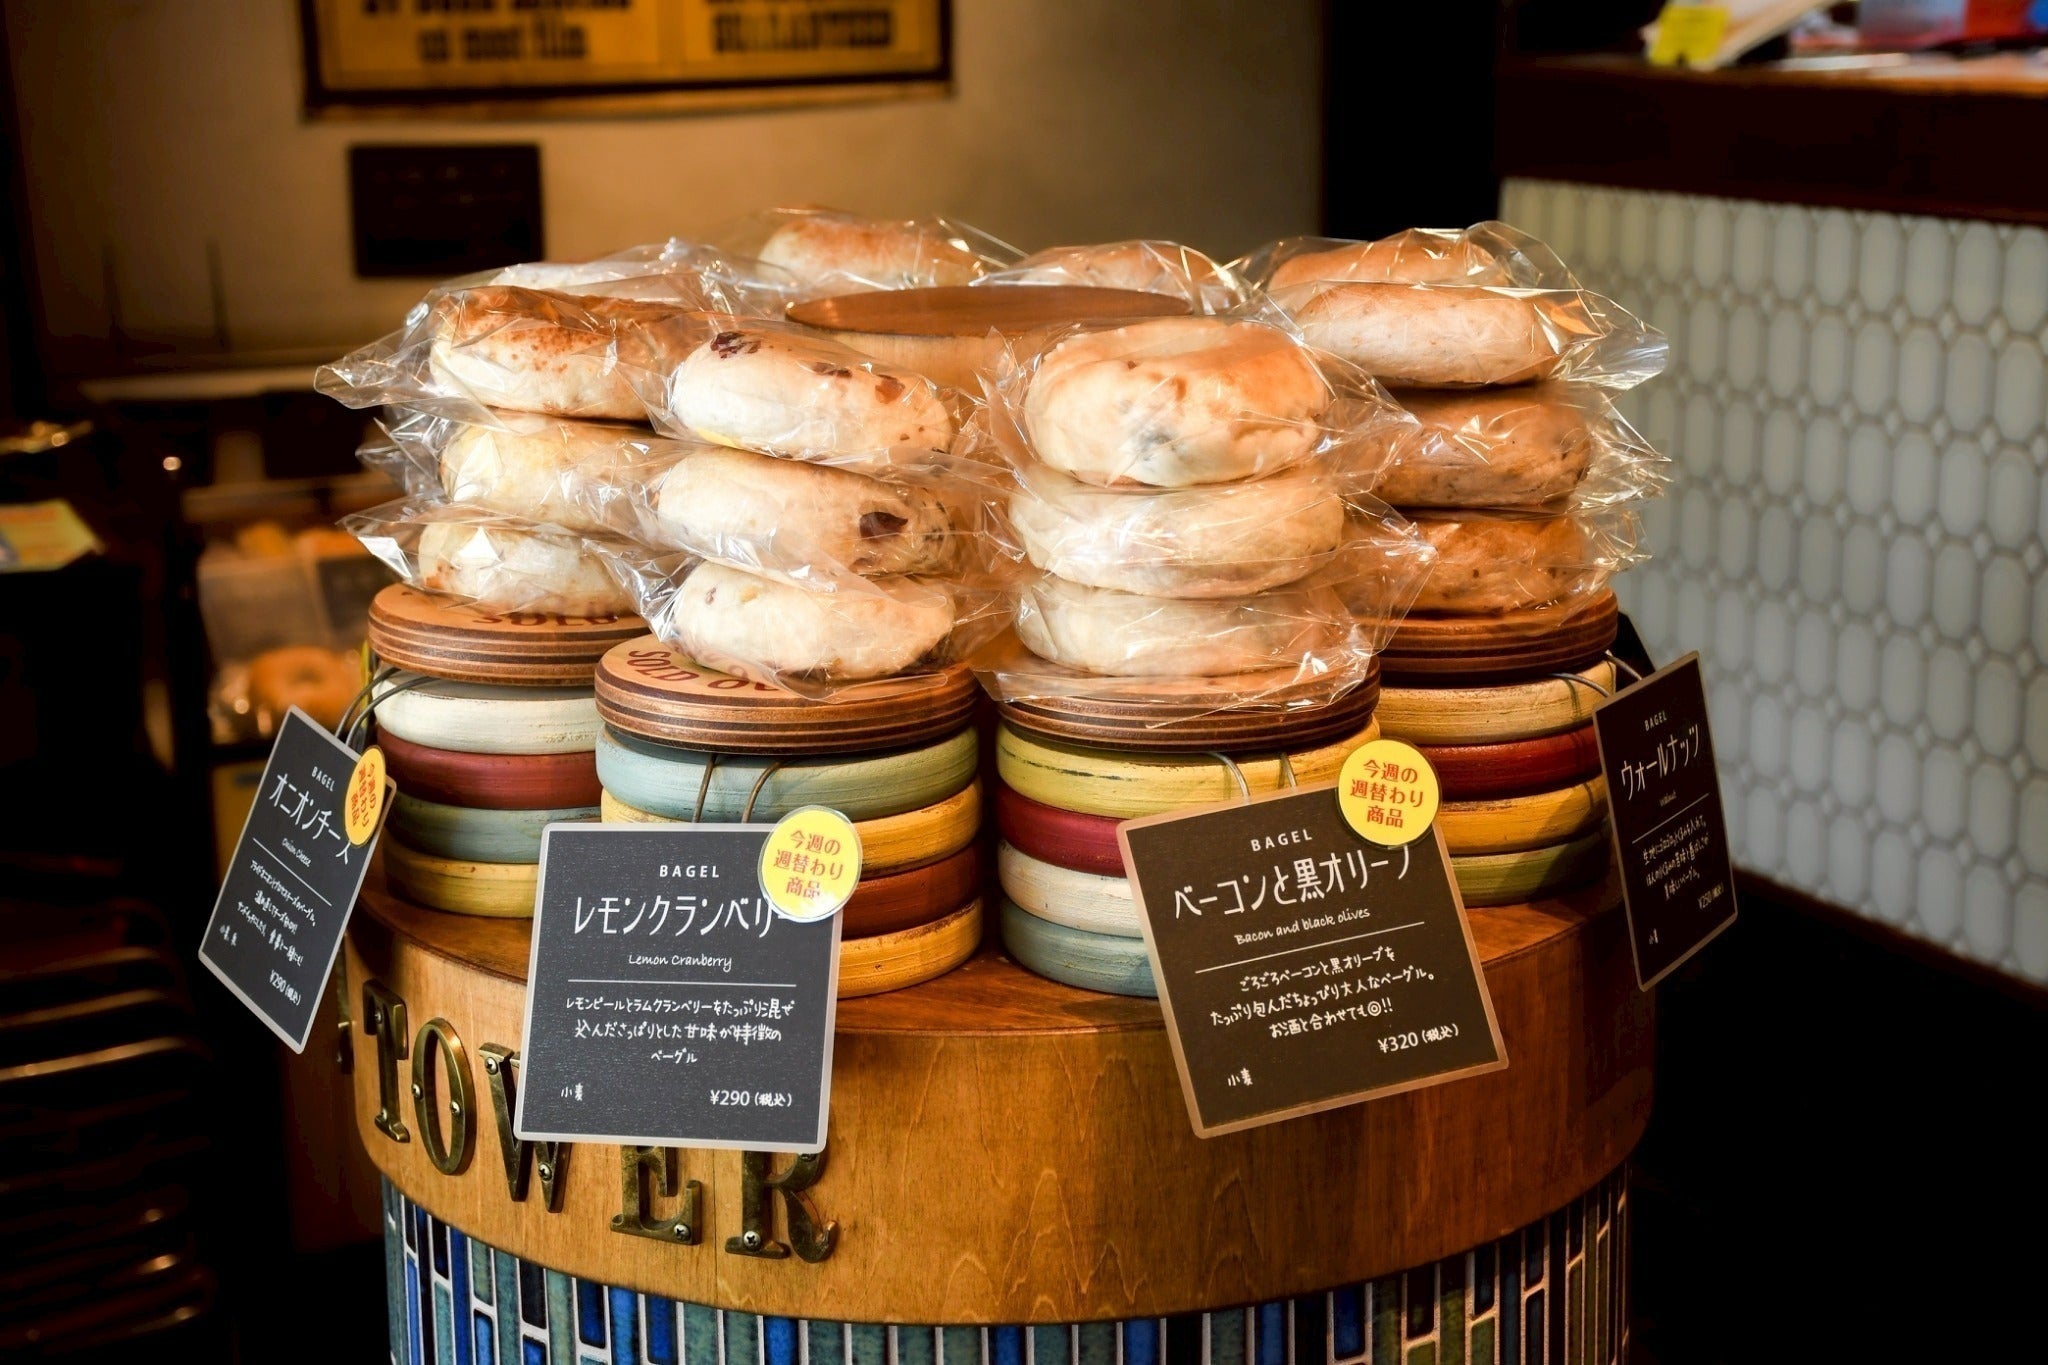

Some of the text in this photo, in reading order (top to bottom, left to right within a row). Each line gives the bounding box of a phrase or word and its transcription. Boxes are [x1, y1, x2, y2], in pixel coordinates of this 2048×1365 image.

[627, 650, 699, 682] SOLD
[1644, 710, 1668, 731] BAGEL
[1363, 759, 1418, 784] 今週の
[1621, 723, 1699, 800] ウォールナッツ
[312, 766, 335, 792] BAGEL
[1351, 778, 1424, 807] 週替わり
[1366, 805, 1404, 829] 商品
[790, 830, 841, 856] 今週の
[1251, 828, 1313, 852] BAGEL
[660, 865, 720, 878] BAGEL
[773, 849, 844, 881] 週替わり
[785, 875, 821, 899] 商品
[1234, 907, 1371, 945] Bacon and black olives
[628, 954, 732, 972] Lemon Cranberry
[1240, 946, 1395, 992] ごろごろベーコンと黒オリーブを
[566, 996, 795, 1020] レモンピールとラムクランベリーをたっぷり混ぜ
[574, 1019, 781, 1046] 込んださっぱりとした甘味が特徴の
[1378, 1032, 1419, 1053] ¥320
[651, 1047, 698, 1064] ベーグル
[1228, 1068, 1253, 1087] 小麦
[560, 1083, 583, 1101] 小麦
[710, 1089, 750, 1106] ¥290
